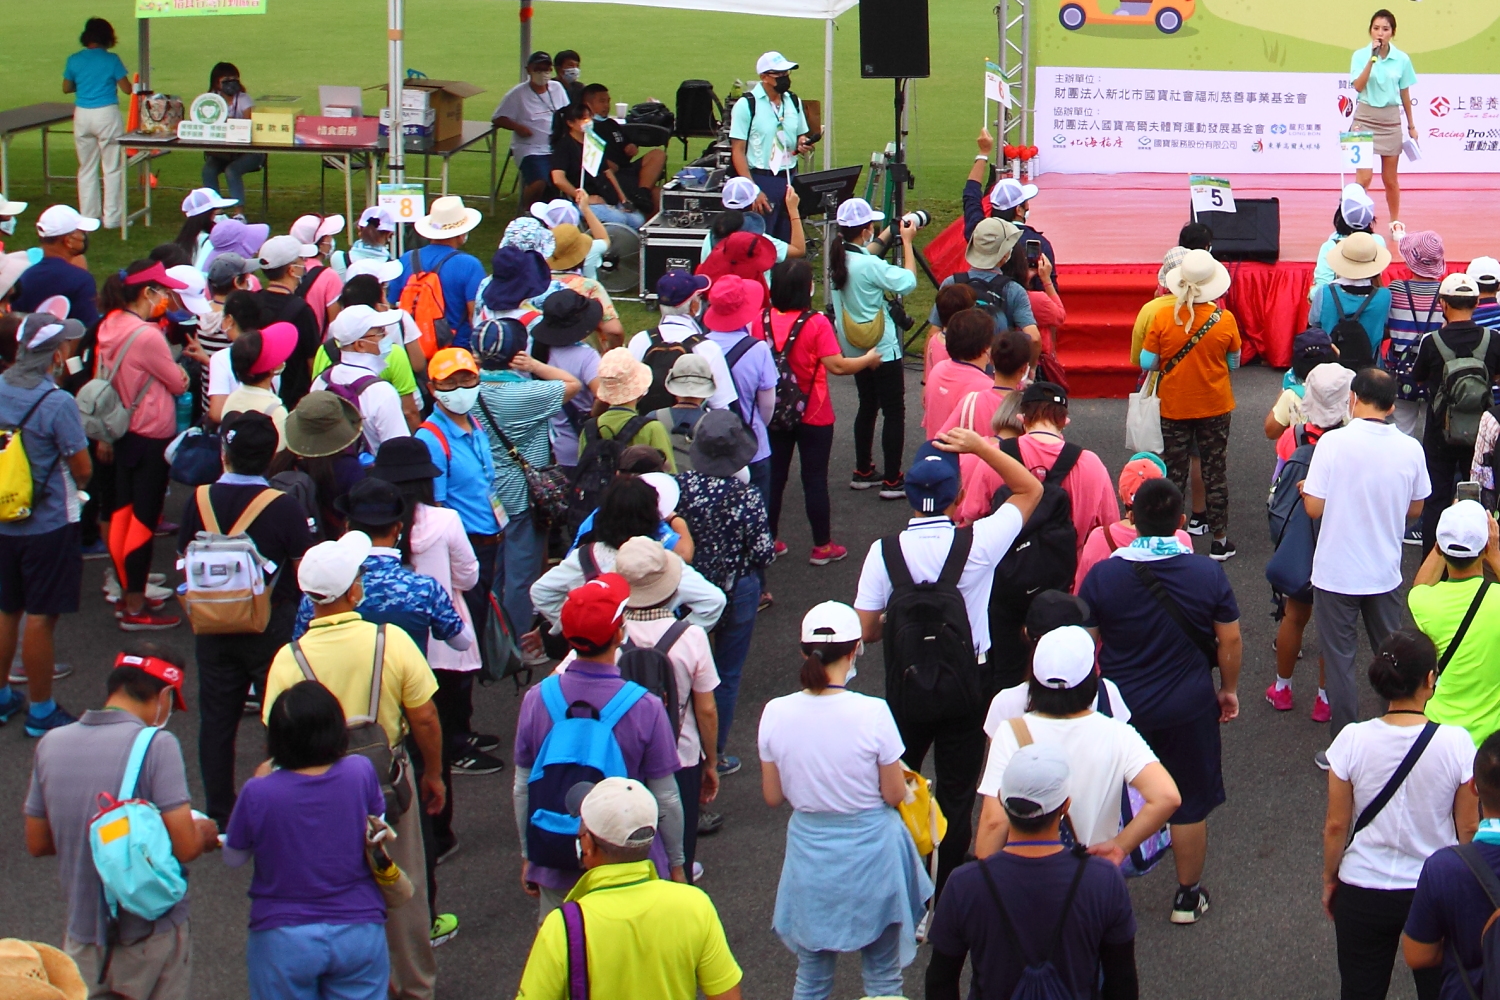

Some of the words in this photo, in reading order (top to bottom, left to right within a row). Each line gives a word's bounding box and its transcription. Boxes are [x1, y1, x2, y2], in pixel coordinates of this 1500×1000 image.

[1428, 128, 1465, 140] Racing
[1466, 128, 1485, 139] Pro
[1350, 145, 1361, 164] 3
[1211, 188, 1223, 207] 5
[400, 197, 413, 218] 8
